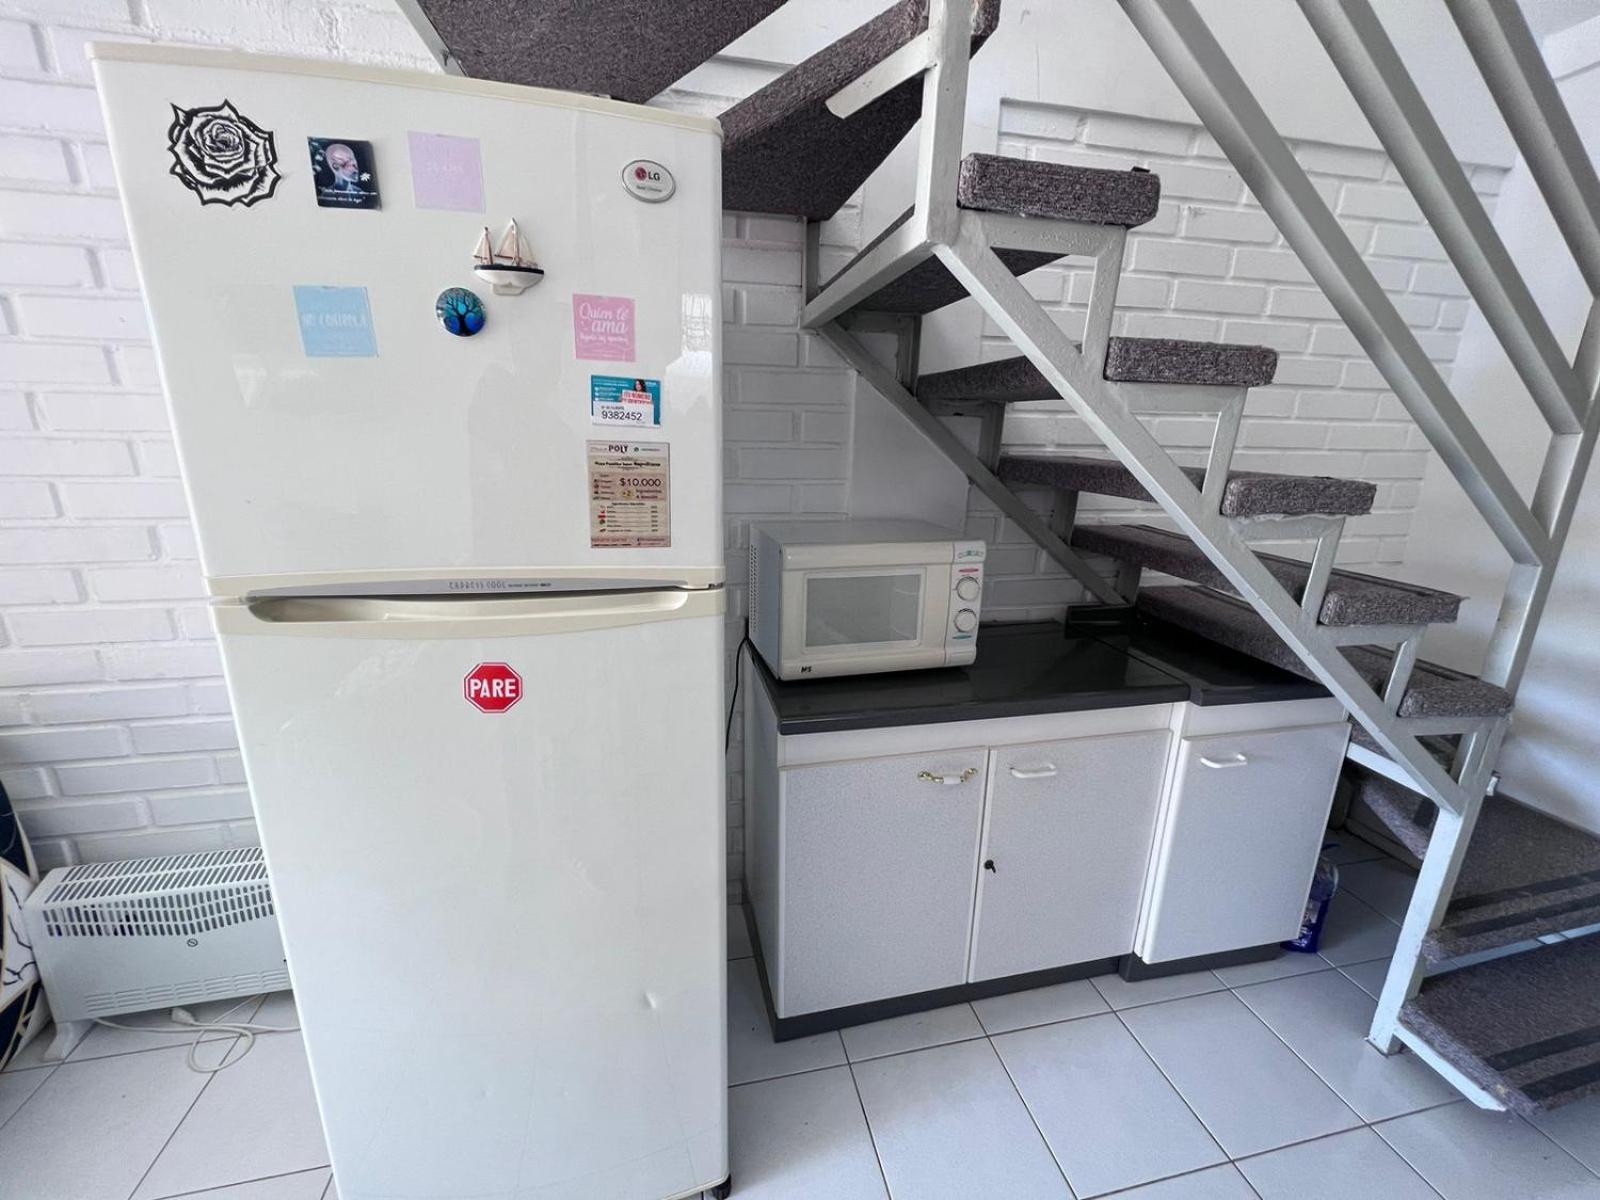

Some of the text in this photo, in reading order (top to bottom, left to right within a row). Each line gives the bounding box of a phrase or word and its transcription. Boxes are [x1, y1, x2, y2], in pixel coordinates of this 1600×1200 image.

[648, 171, 660, 181] LG
[592, 320, 626, 334] ama
[601, 410, 643, 421] 9382452
[619, 478, 661, 487] $10.000
[470, 678, 517, 698] PARE
